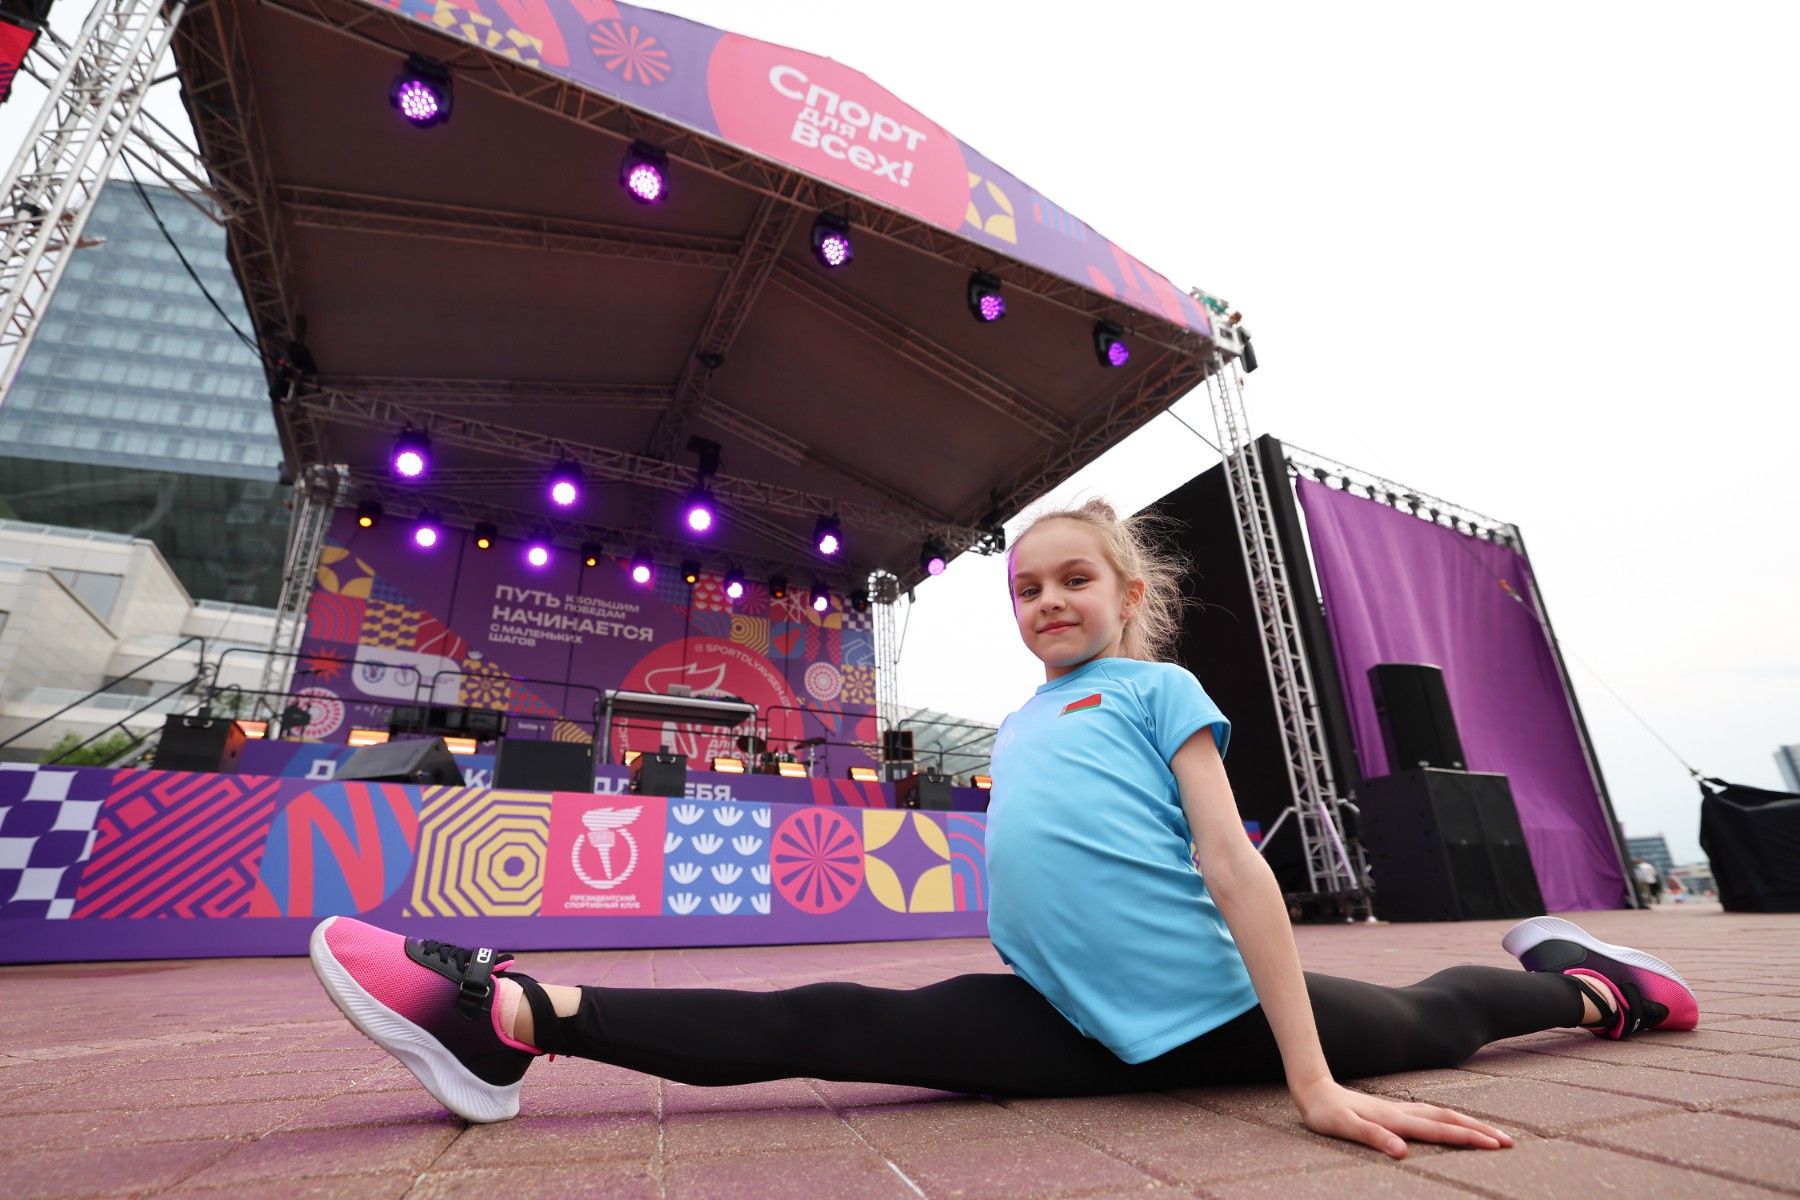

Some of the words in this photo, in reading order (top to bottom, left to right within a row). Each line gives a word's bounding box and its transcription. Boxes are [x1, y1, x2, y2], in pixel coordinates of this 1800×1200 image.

[769, 65, 927, 151] Спорт
[790, 120, 913, 187] Всех!
[495, 585, 561, 609] ПУТЬ
[576, 595, 640, 613] БОЛЬШИМ
[564, 603, 626, 620] ПОБЕДАМ
[492, 605, 653, 642] НАЧИНАЕТСЯ
[501, 626, 583, 644] МАЛЕНЬКИХ
[488, 634, 536, 647] ШАГОВ
